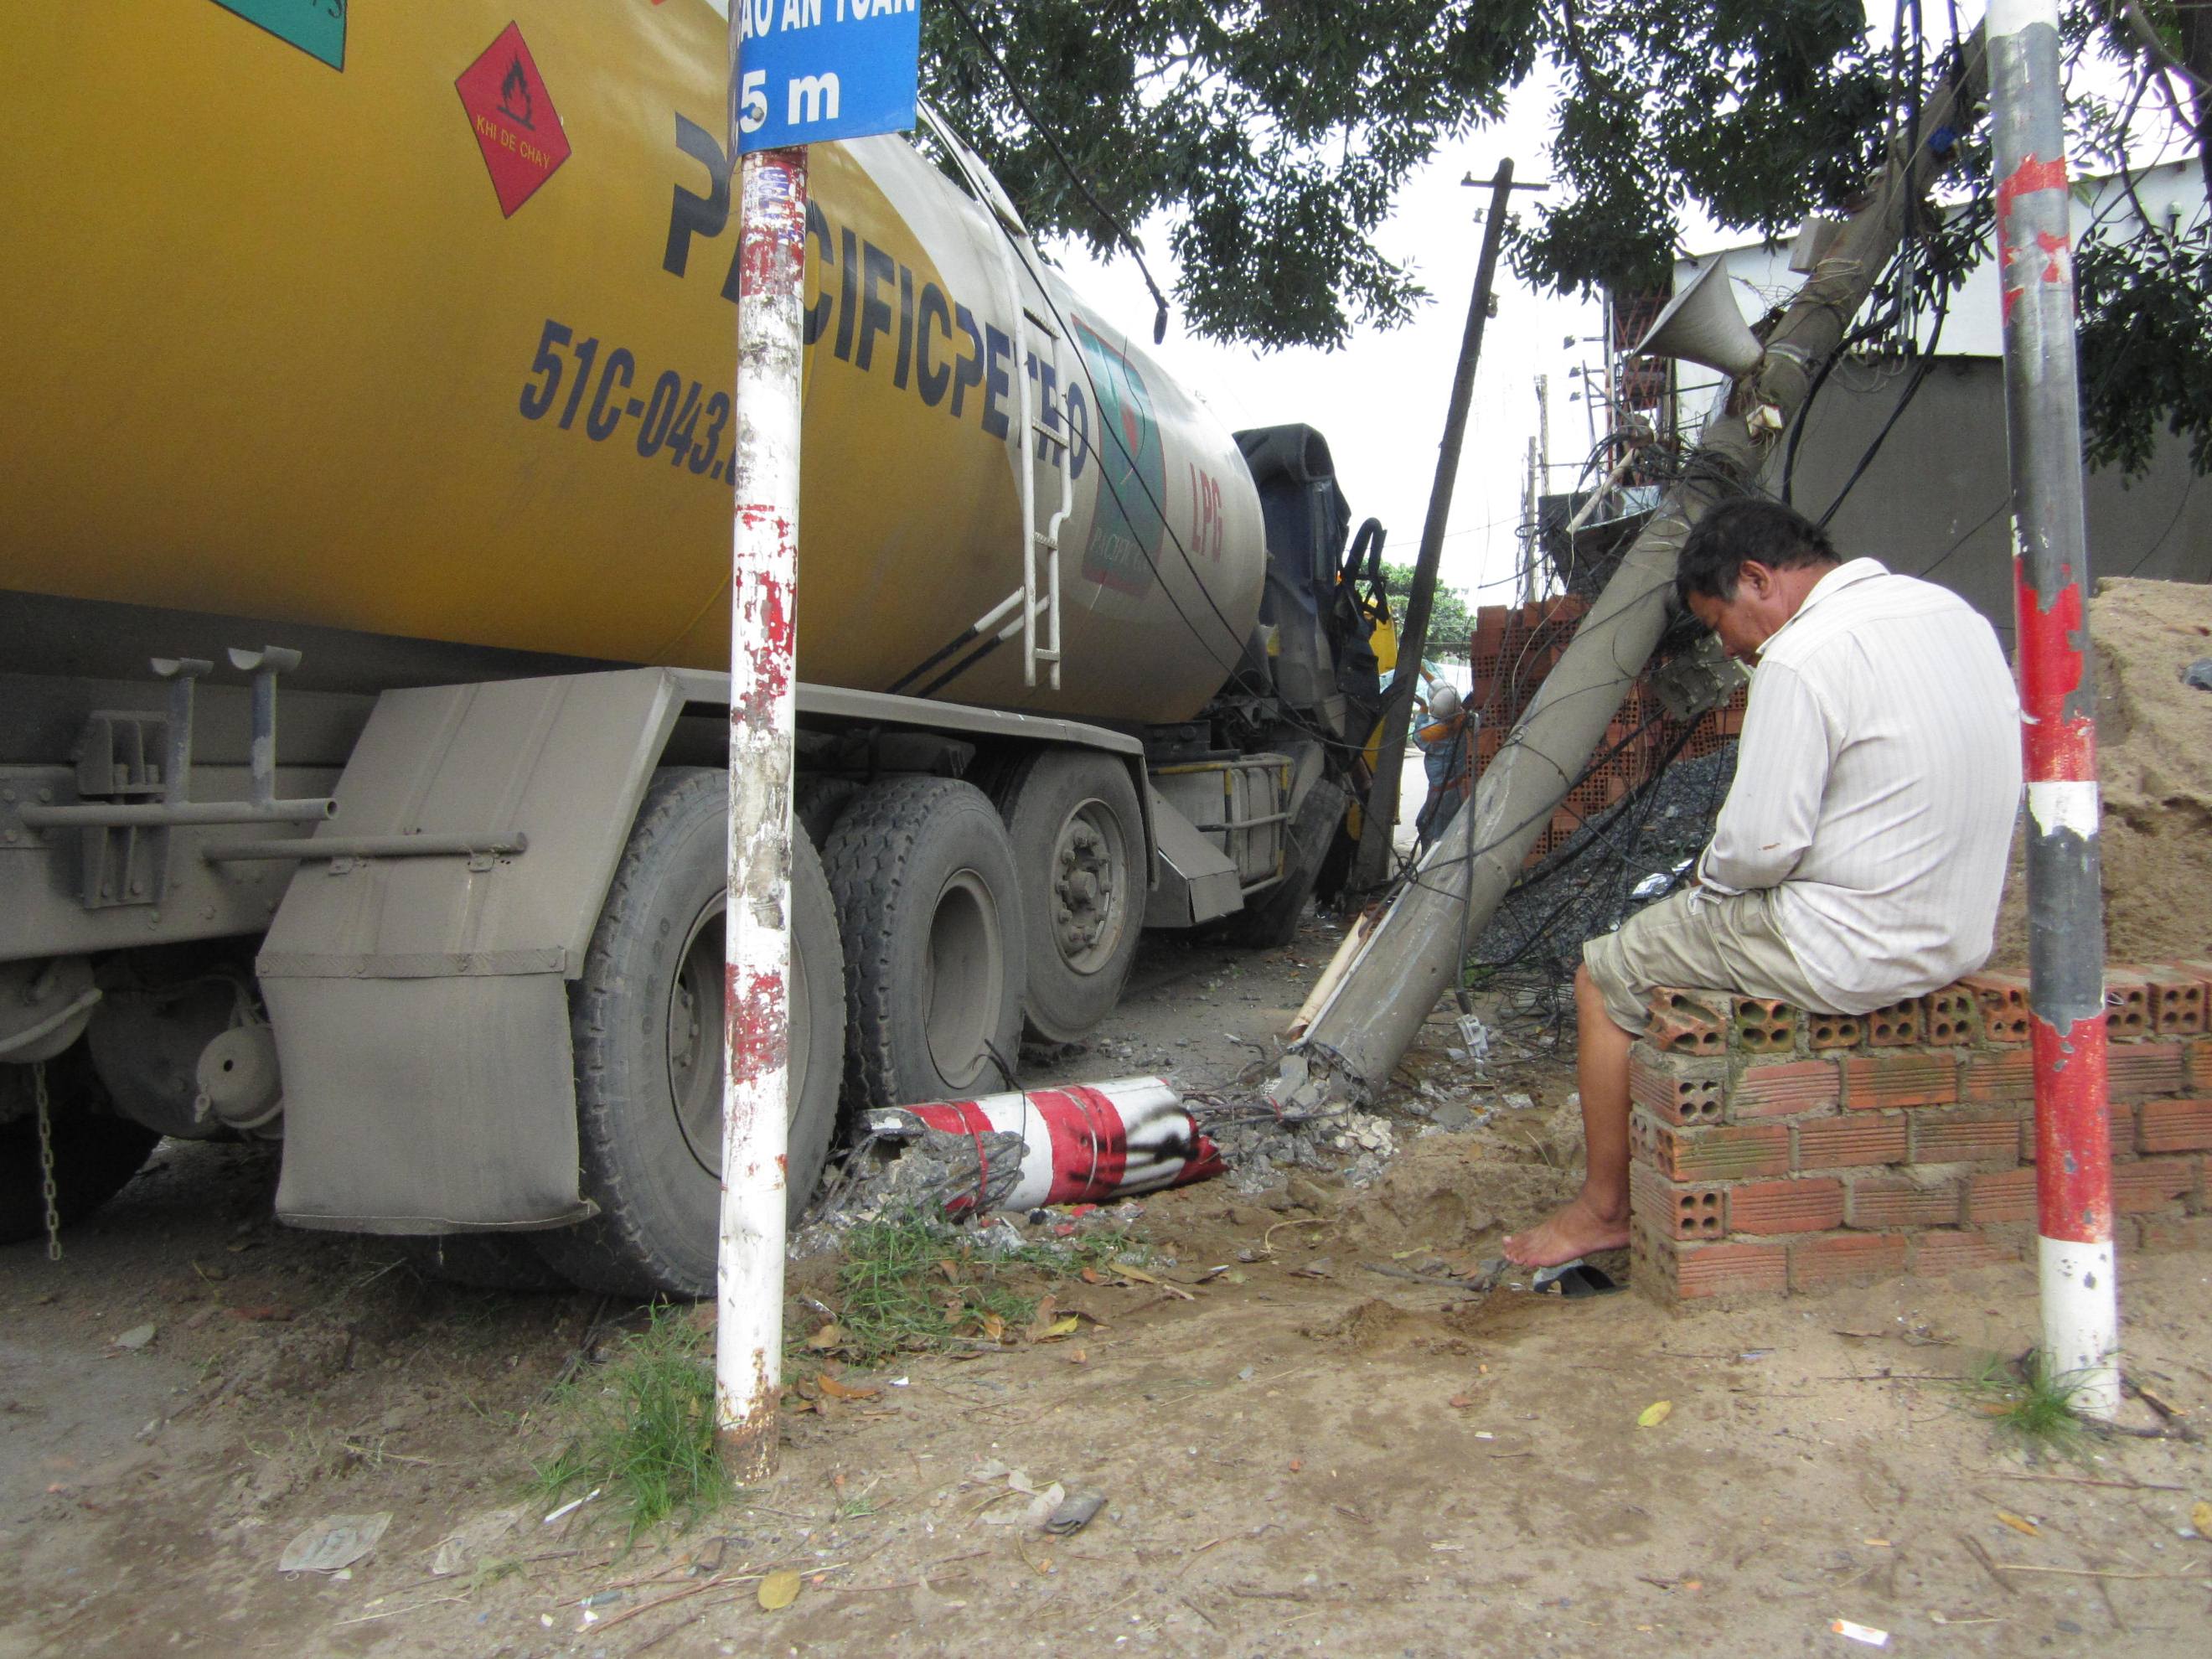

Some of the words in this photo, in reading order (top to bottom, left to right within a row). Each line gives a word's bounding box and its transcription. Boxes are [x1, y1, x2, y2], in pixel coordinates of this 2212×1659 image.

[788, 72, 840, 126] m
[476, 114, 497, 141] KHI
[501, 128, 516, 152] DE
[519, 141, 550, 169] CHAY
[519, 318, 737, 486] 51C-043.
[1190, 462, 1224, 564] LPG
